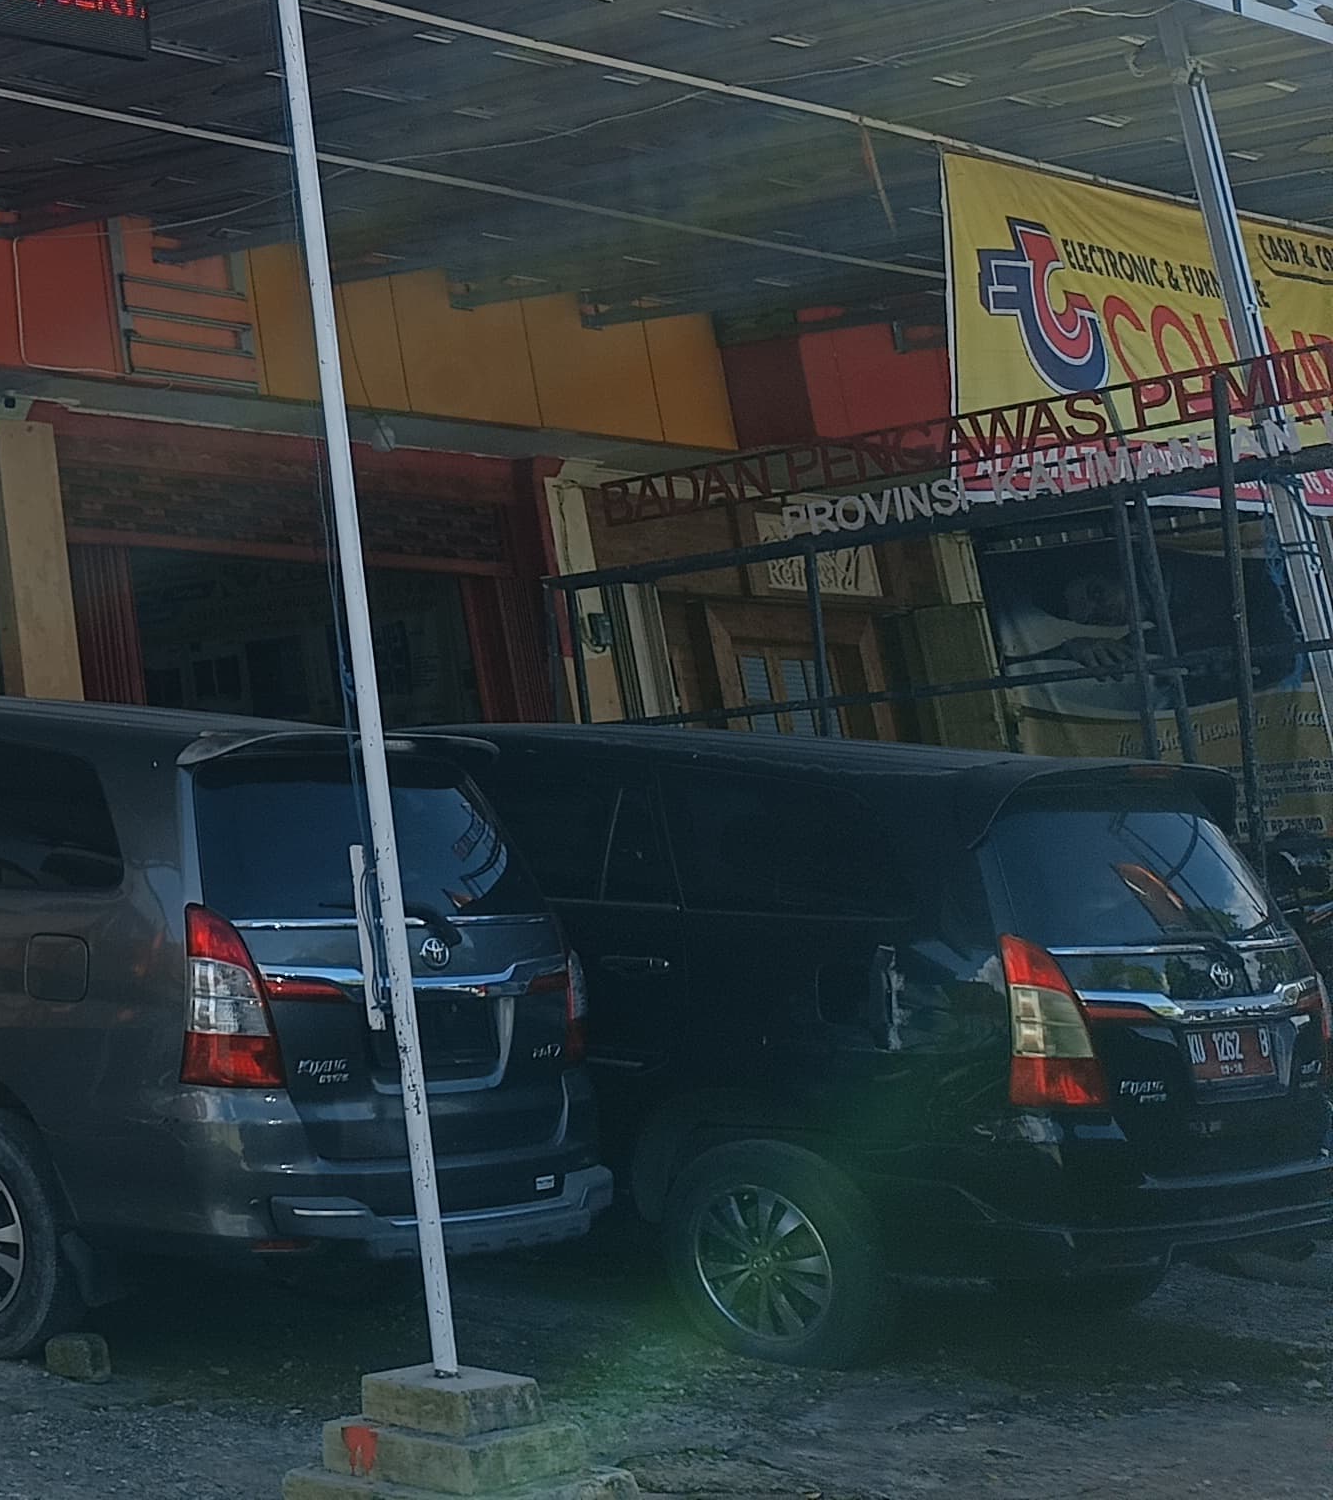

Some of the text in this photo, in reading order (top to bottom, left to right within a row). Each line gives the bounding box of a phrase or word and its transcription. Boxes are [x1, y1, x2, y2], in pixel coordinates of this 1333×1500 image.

[1061, 238, 1165, 288] ELECTRONIC
[1165, 261, 1182, 291] &
[1258, 234, 1300, 265] CASH
[1300, 242, 1317, 268] &
[600, 455, 772, 527] BADAN
[783, 393, 1107, 493] PENGAWAS
[782, 476, 970, 540] PROVINSI
[990, 416, 1303, 506] KALIMANAN
[1187, 1033, 1206, 1064] KU
[1212, 1031, 1244, 1062] 1262
